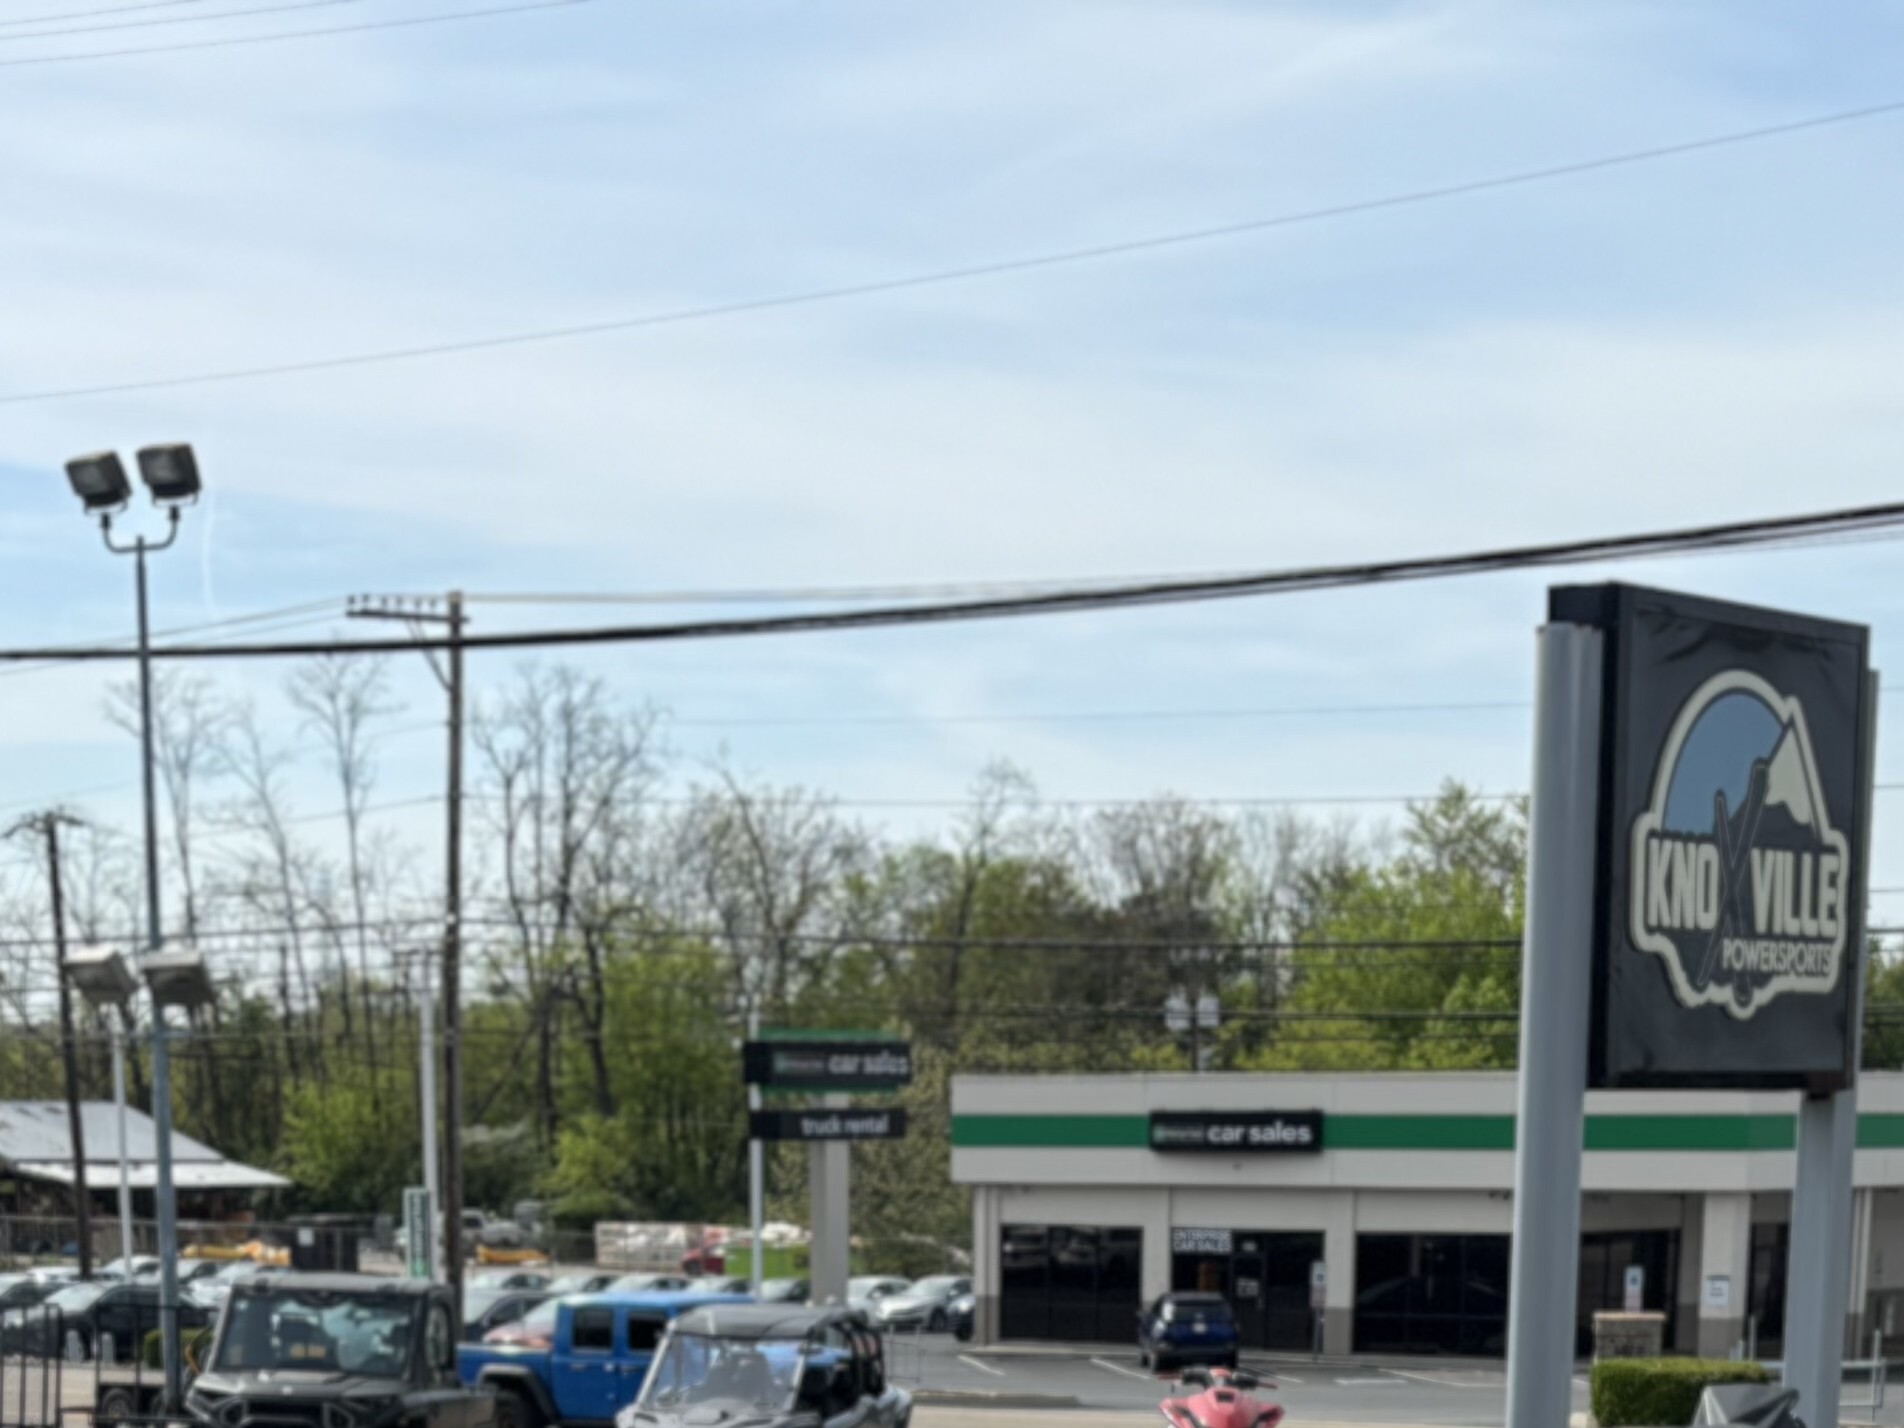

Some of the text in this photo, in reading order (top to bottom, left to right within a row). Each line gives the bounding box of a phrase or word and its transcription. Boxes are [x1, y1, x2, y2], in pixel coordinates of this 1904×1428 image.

[1722, 938, 1833, 975] POWERSPORTS
[801, 1114, 889, 1135] truck rental
[1206, 1124, 1244, 1143] car
[1248, 1119, 1313, 1143] sales
